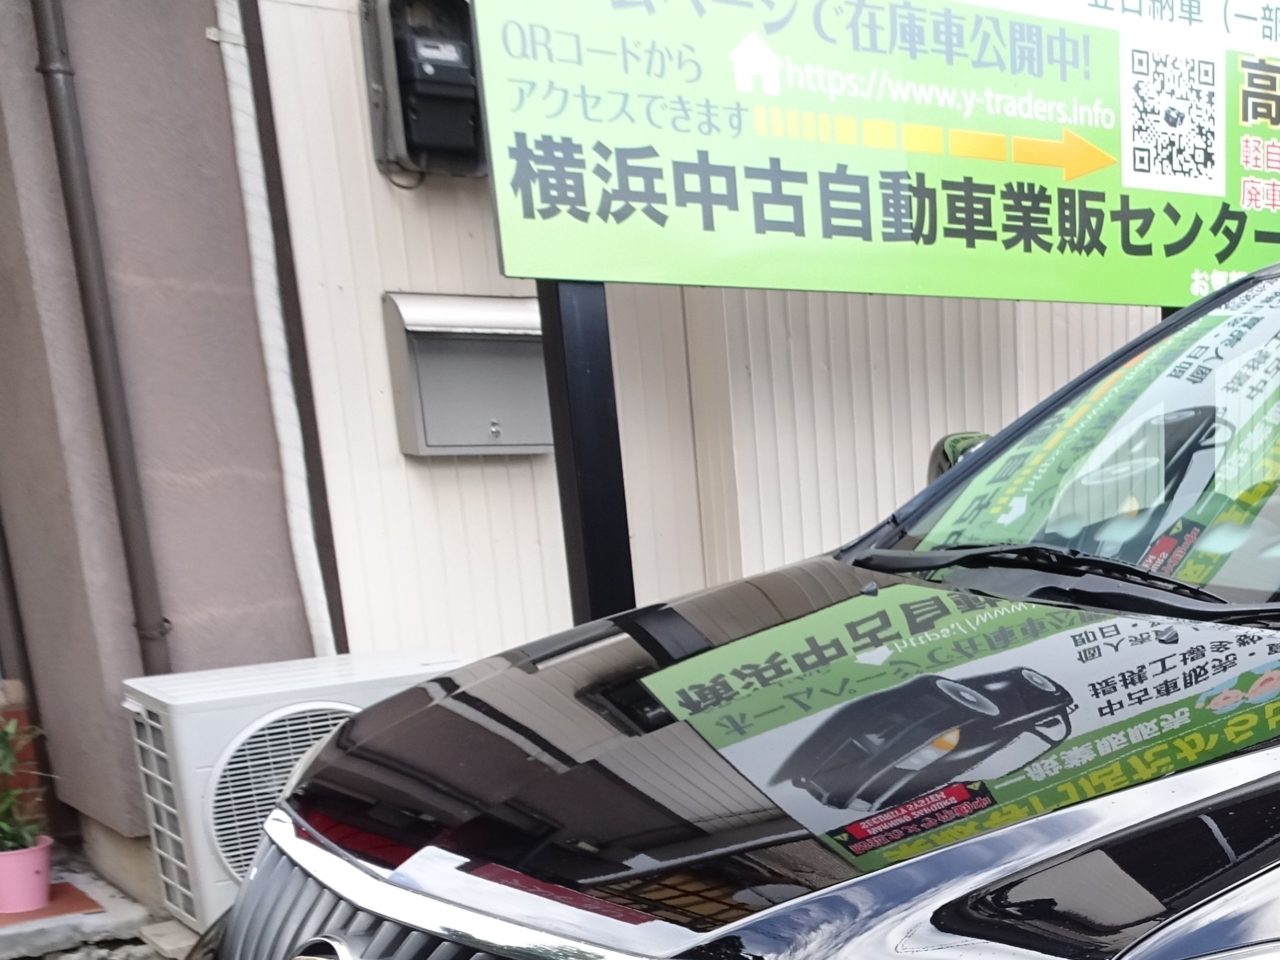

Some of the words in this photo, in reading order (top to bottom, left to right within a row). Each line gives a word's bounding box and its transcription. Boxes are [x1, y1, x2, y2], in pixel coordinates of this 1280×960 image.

[502, 20, 702, 84] QRコードから
[507, 77, 749, 139] アクセスできます
[785, 56, 1115, 130] https://www.y-traders.info
